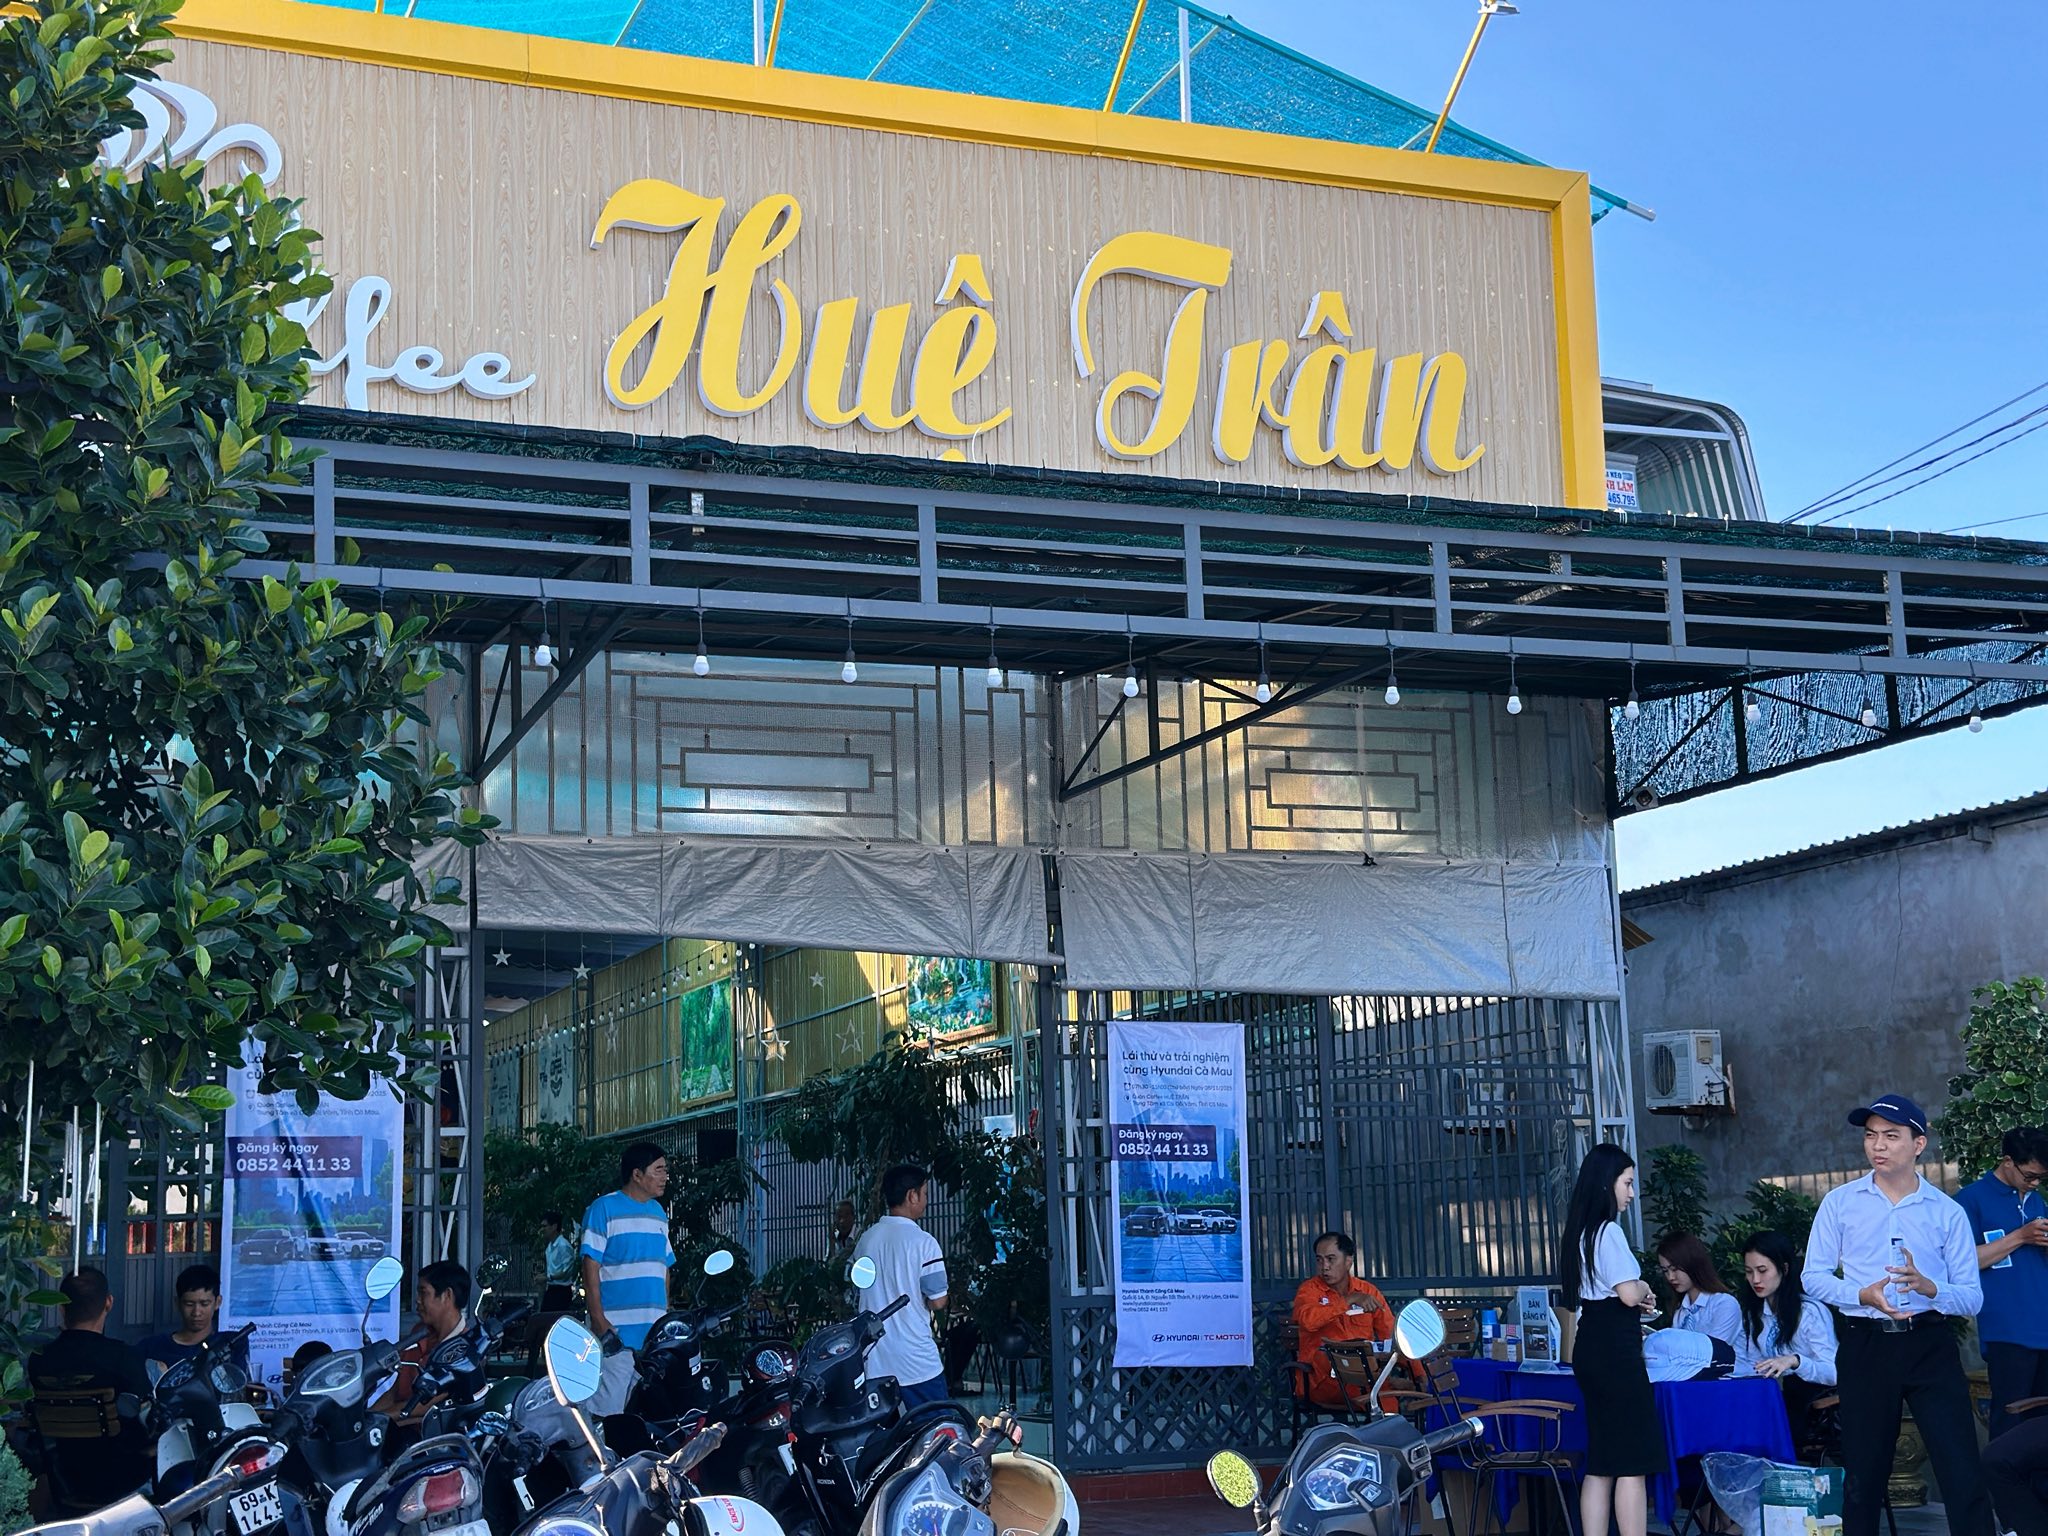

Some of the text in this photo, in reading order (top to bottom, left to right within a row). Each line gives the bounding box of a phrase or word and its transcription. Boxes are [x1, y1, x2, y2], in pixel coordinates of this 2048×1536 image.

[1070, 231, 1486, 476] Trân
[247, 1052, 264, 1064] Lá
[1122, 1050, 1230, 1064] Lái thử và trải nghiệm
[1124, 1065, 1232, 1077] cùng Hyundai Cà Mau
[1119, 1130, 1184, 1140] Đăng ký ngay
[237, 1142, 319, 1154] Đăng ký ngay
[1119, 1144, 1208, 1156] 0852 44 11 33
[236, 1158, 350, 1172] 0852 44 11 33
